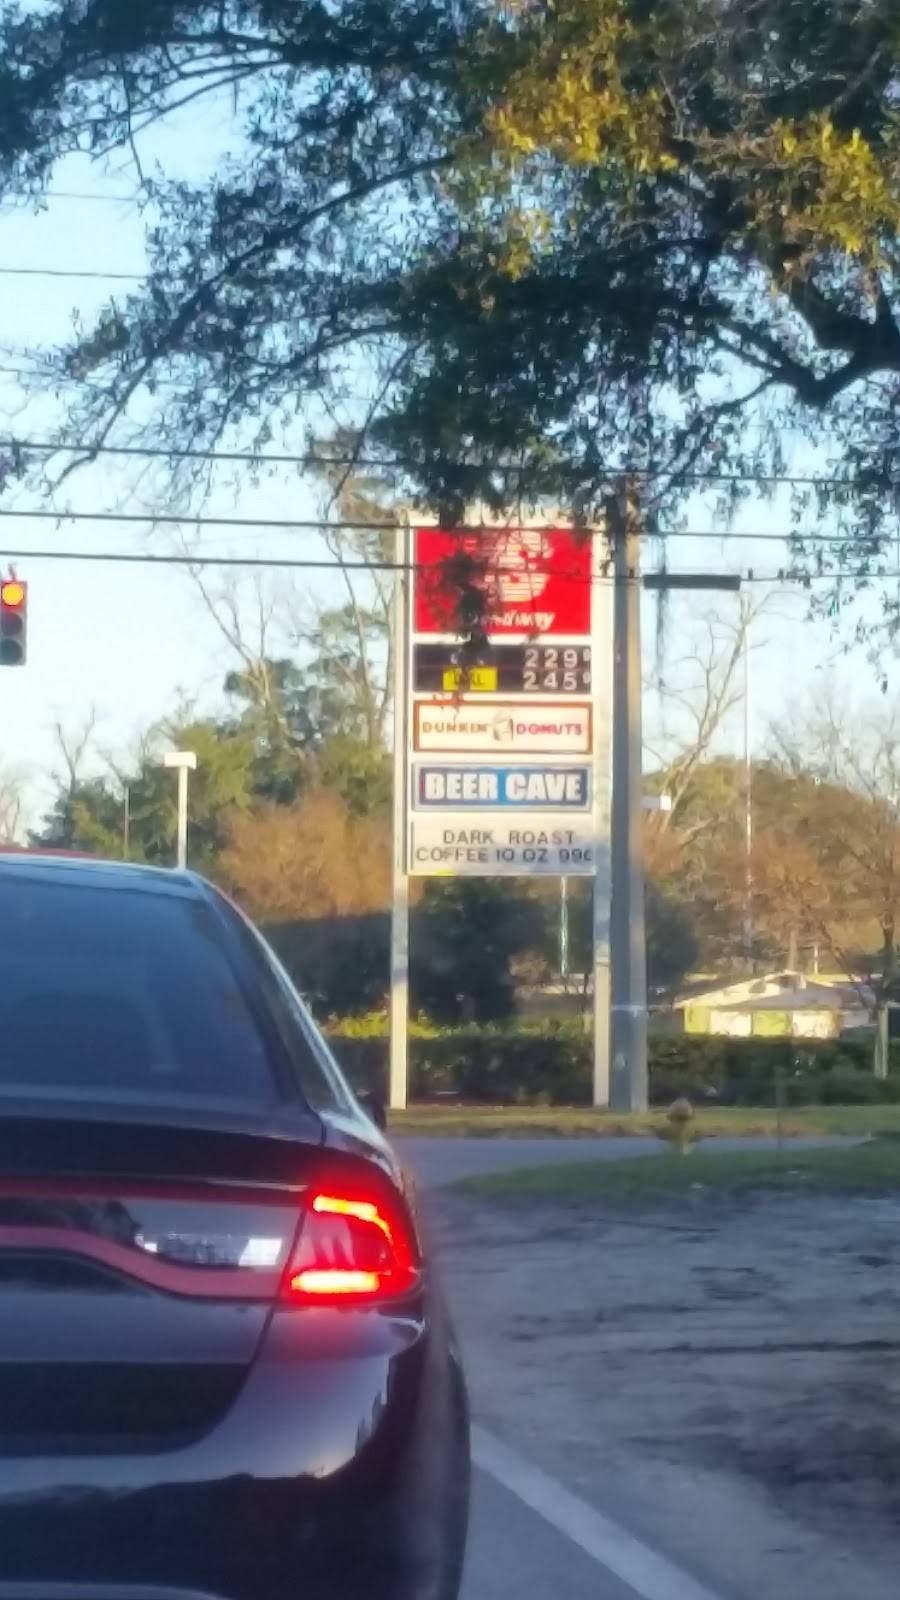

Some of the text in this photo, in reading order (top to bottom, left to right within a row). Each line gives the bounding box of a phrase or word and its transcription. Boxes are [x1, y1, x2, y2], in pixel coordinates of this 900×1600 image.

[515, 723, 583, 736] DONUTS
[424, 772, 582, 801] BEER CAVE
[442, 829, 576, 845] DARK ROAST
[415, 847, 489, 862] COFFEE
[522, 849, 548, 863] OZ
